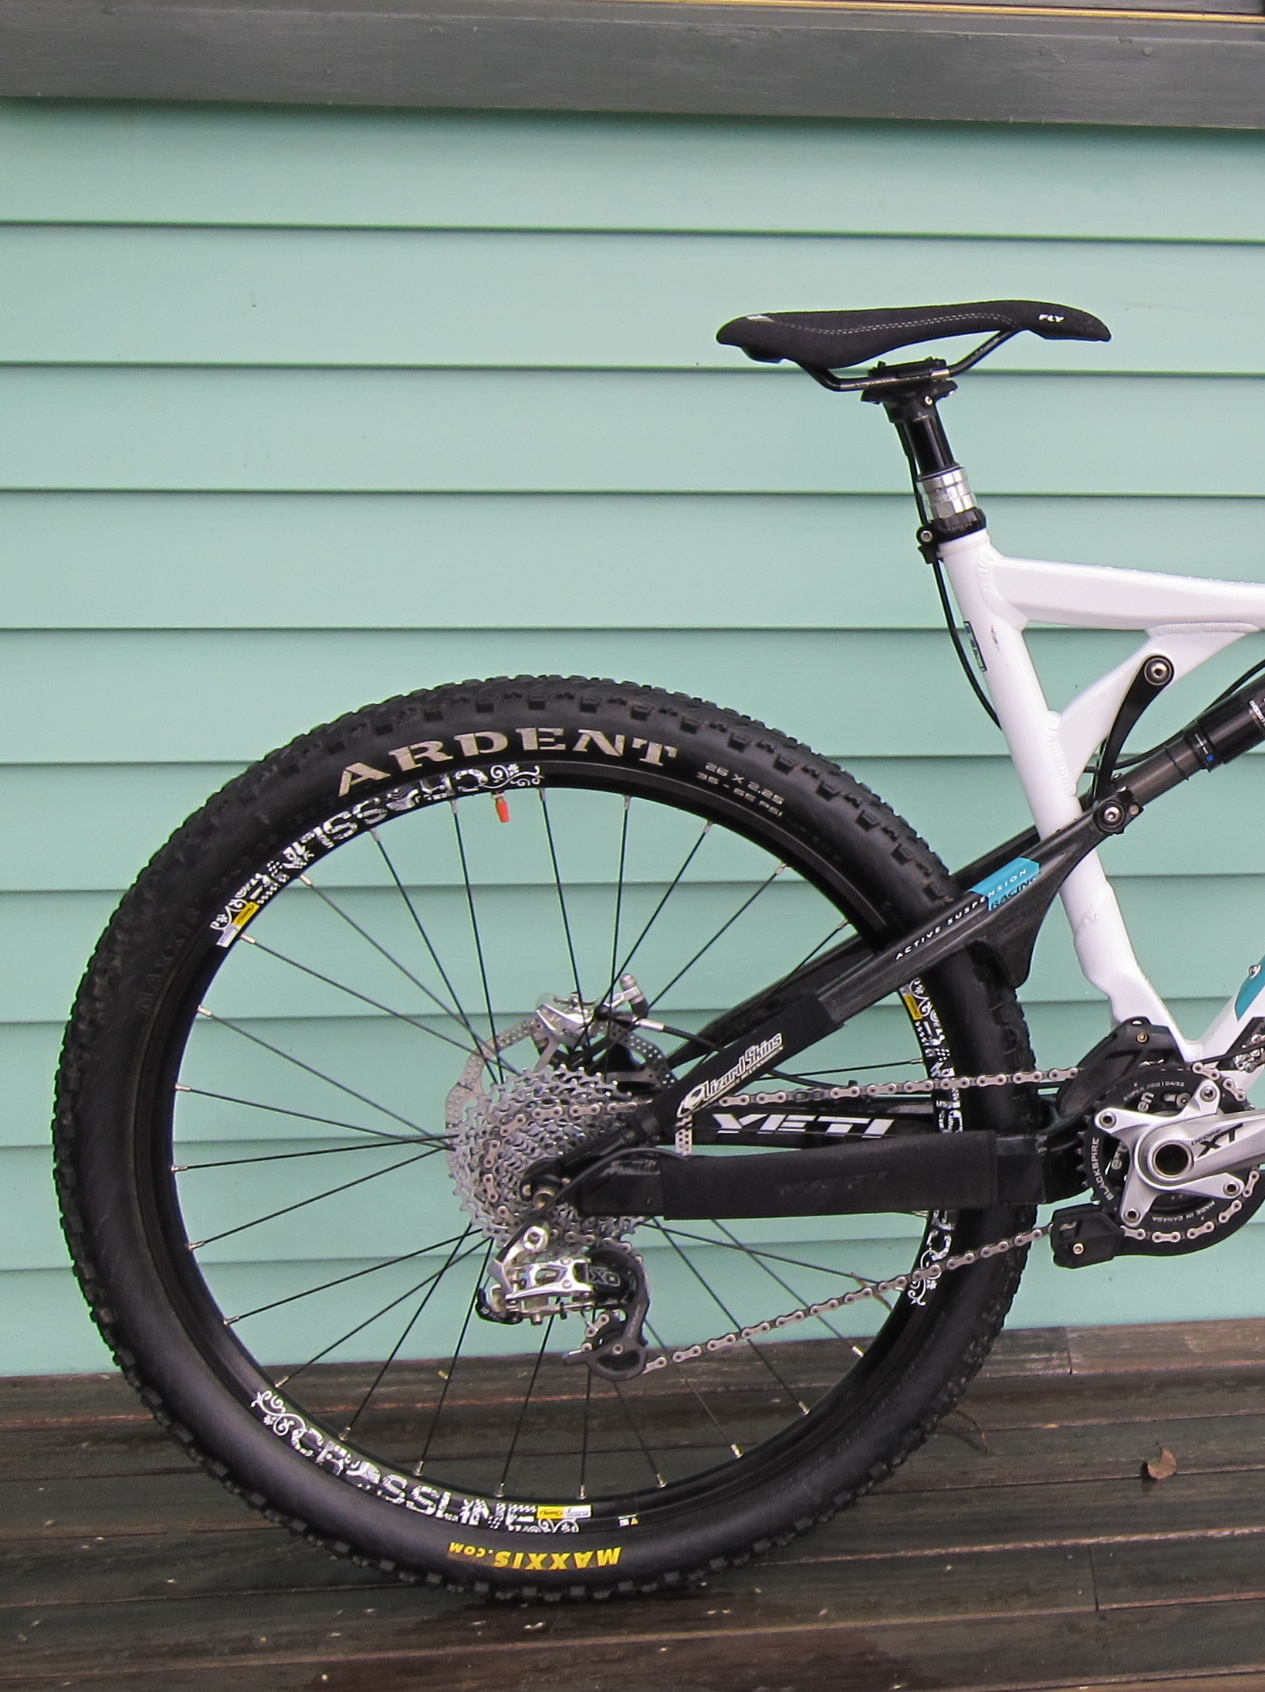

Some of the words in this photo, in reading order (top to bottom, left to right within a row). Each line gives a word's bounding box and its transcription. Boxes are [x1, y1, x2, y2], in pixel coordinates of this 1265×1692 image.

[1038, 313, 1065, 323] FLY
[337, 727, 679, 798] ARDENT
[895, 926, 941, 960] ACTIVE
[946, 868, 1028, 926] SUSPENSION
[712, 1113, 896, 1139] YETI
[1197, 1123, 1243, 1159] XT
[1091, 1137, 1114, 1201] BLACKSPIRE
